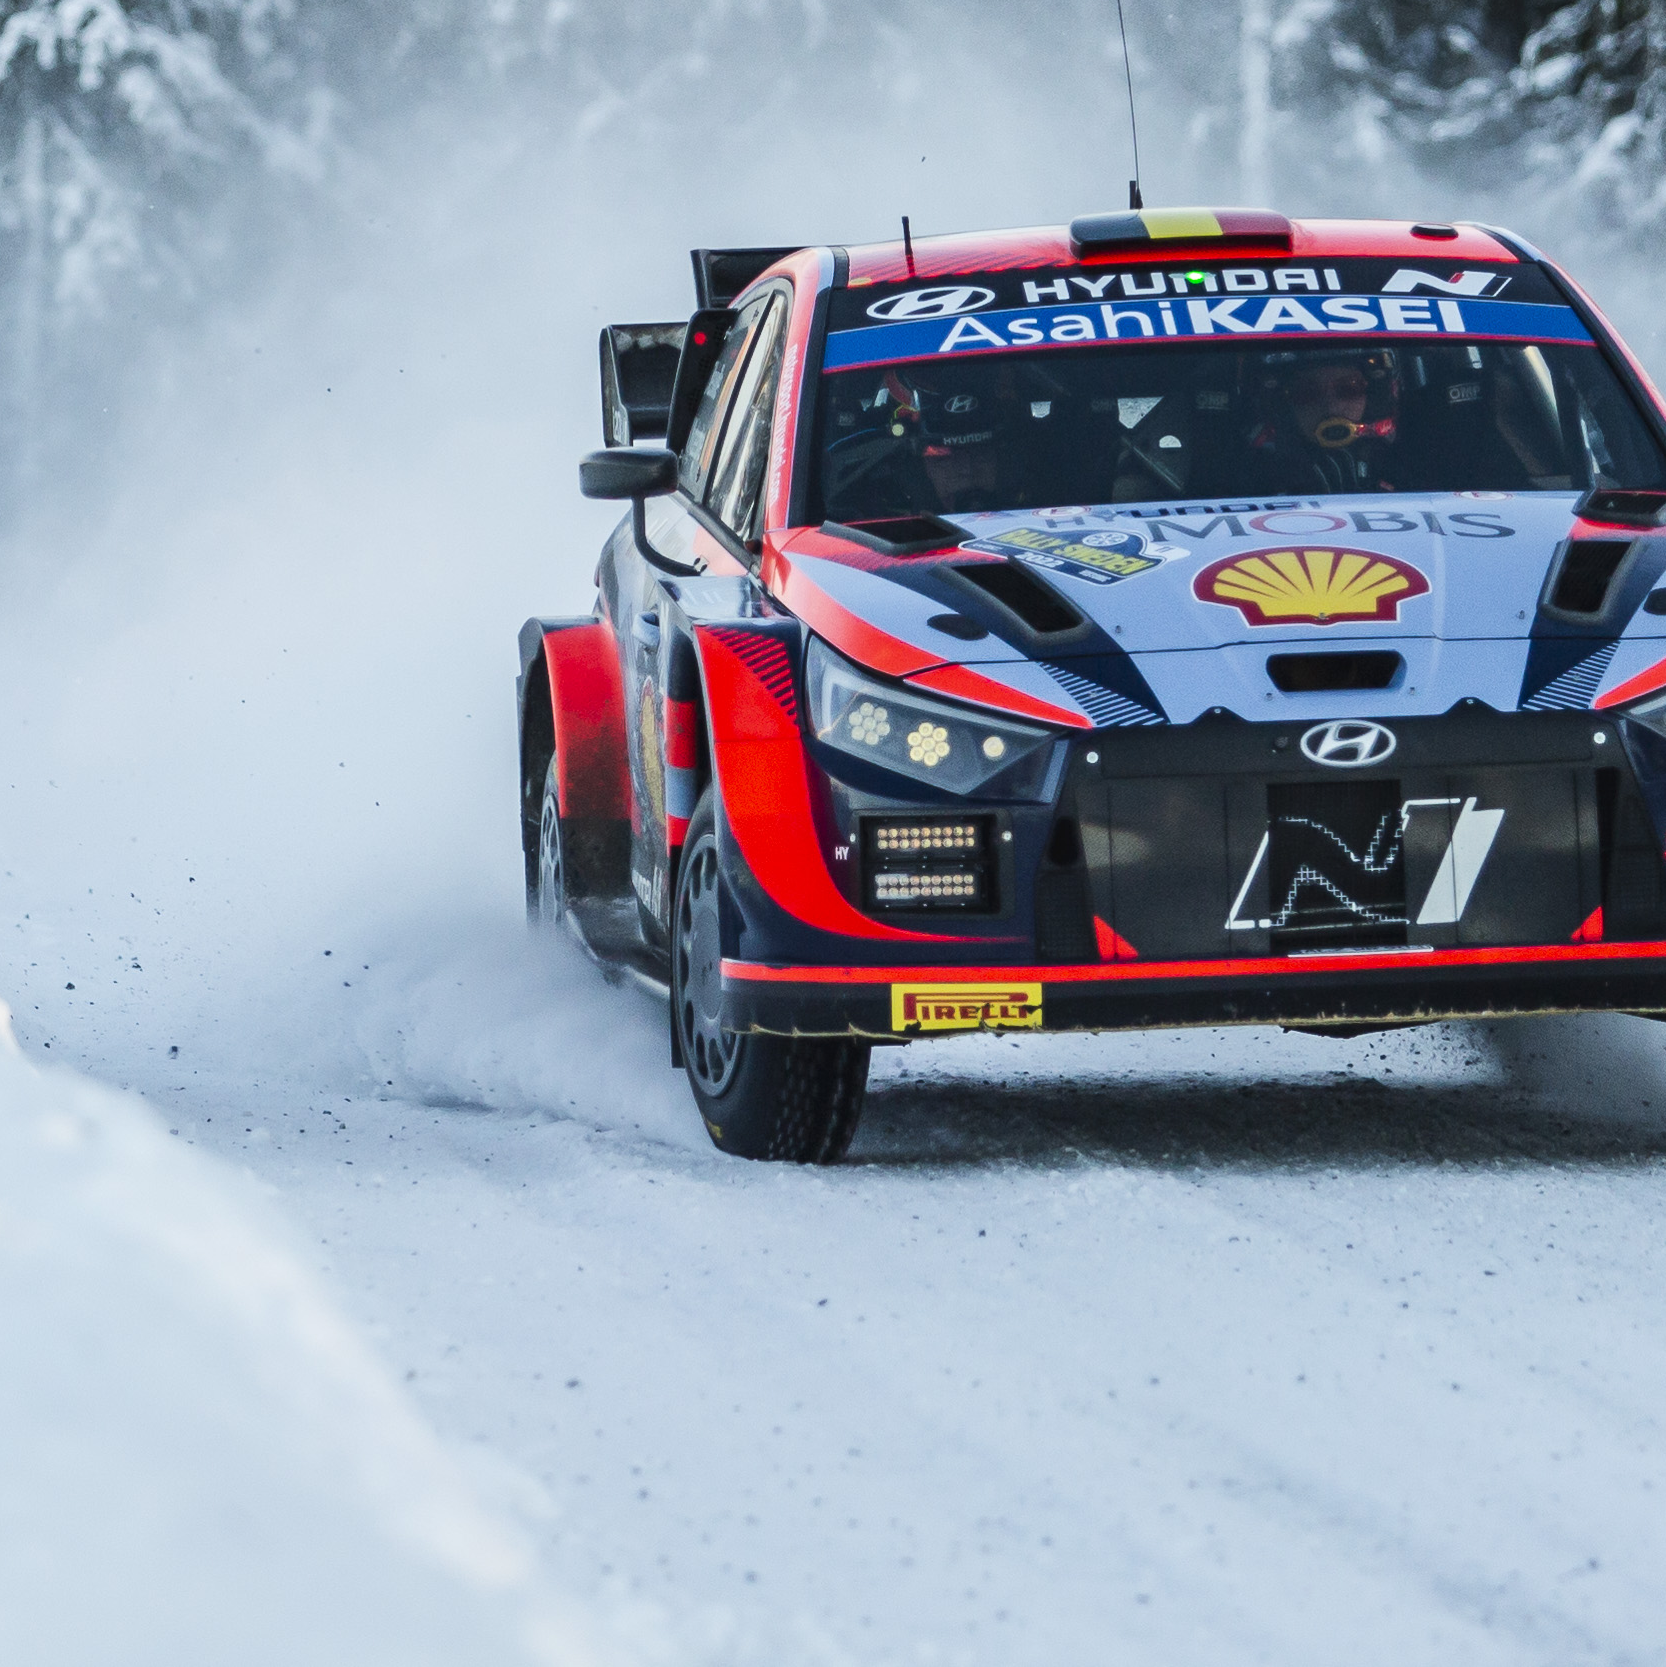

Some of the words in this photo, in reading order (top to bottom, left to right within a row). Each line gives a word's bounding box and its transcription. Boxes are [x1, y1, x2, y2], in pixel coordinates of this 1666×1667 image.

[1025, 268, 1341, 303] HYUNDAI
[942, 431, 993, 446] HYUNDAI
[1044, 500, 1321, 529] HYUNDAI
[1145, 511, 1516, 542] MOBIS
[1053, 544, 1156, 575] SWEDEN
[903, 992, 1029, 1021] PIRELLI
